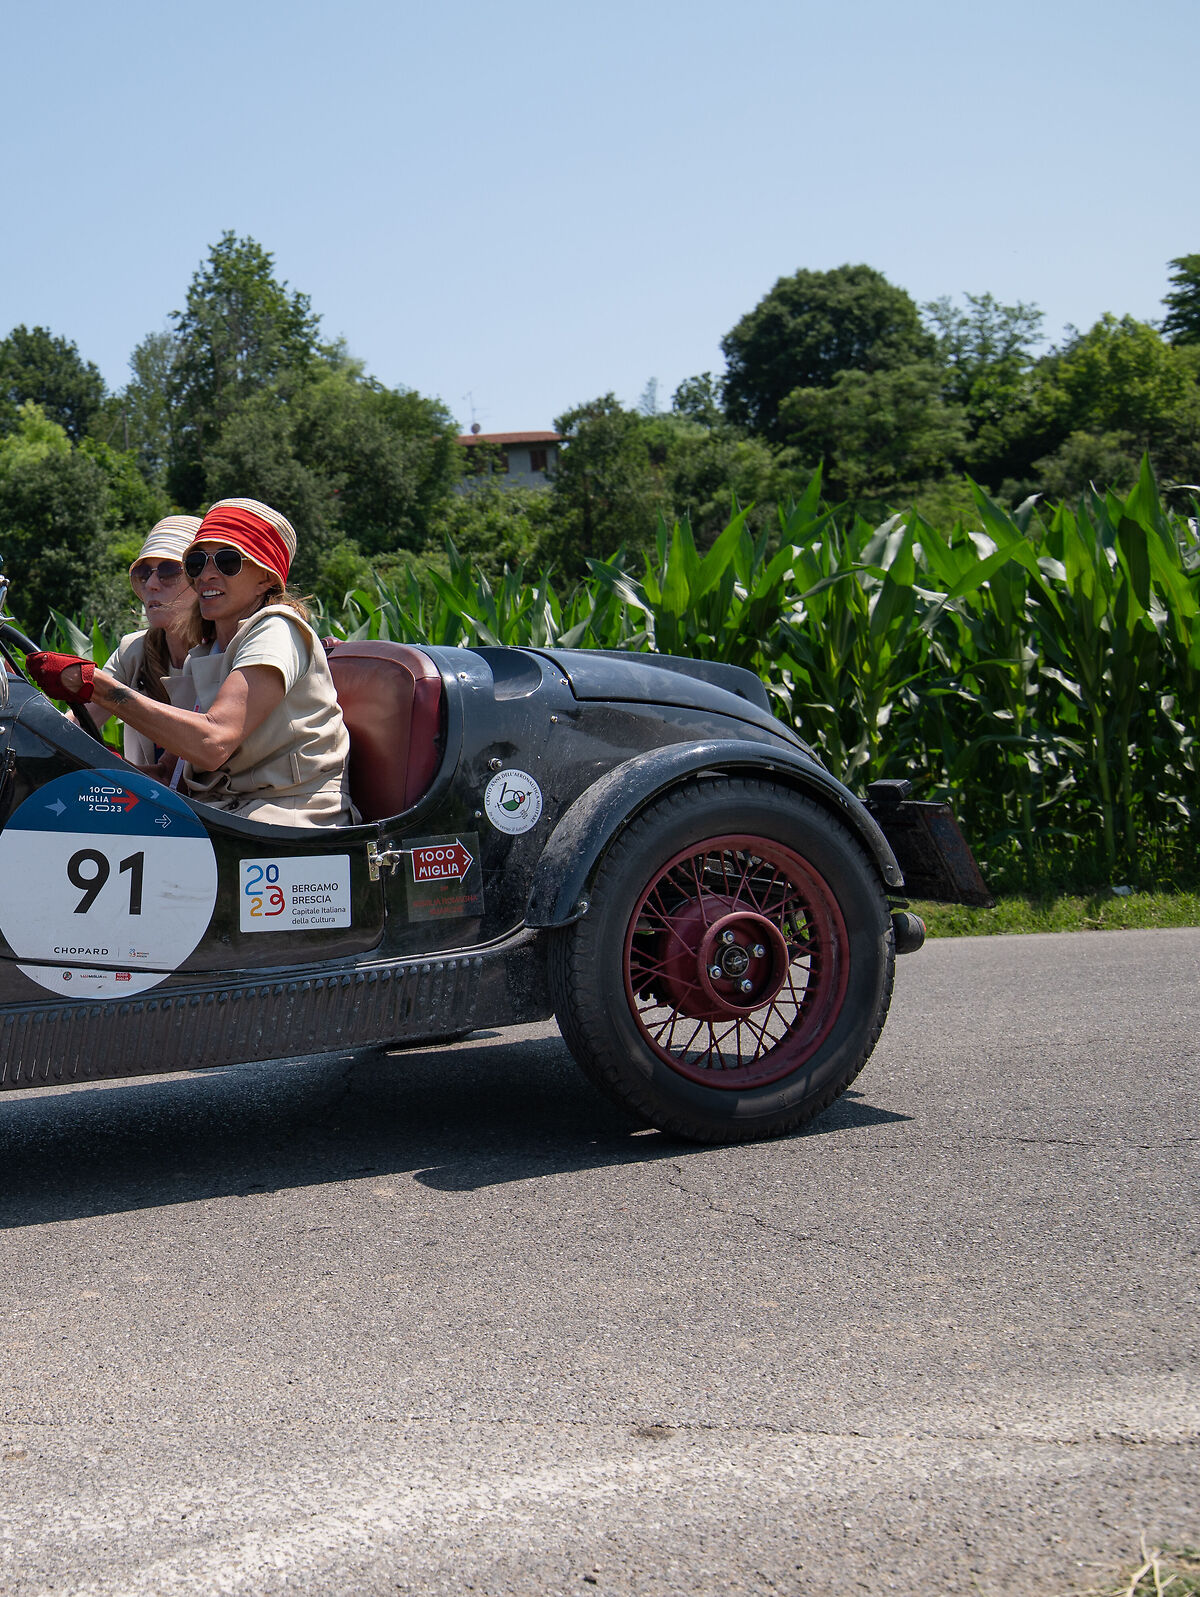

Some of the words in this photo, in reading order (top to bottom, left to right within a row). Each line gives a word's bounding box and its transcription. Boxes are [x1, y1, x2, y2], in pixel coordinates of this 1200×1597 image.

[90, 786, 122, 794] 1000
[78, 794, 109, 802] MIGLIA
[88, 804, 122, 812] 2023
[420, 849, 454, 862] 1000
[418, 863, 459, 878] MIGLIA
[67, 848, 144, 915] 91
[292, 883, 338, 892] BERGAMO
[292, 895, 332, 904] BRESCIA
[292, 908, 320, 917] Capitale
[321, 906, 346, 914] Italiana
[54, 946, 108, 955] CHOPARD
